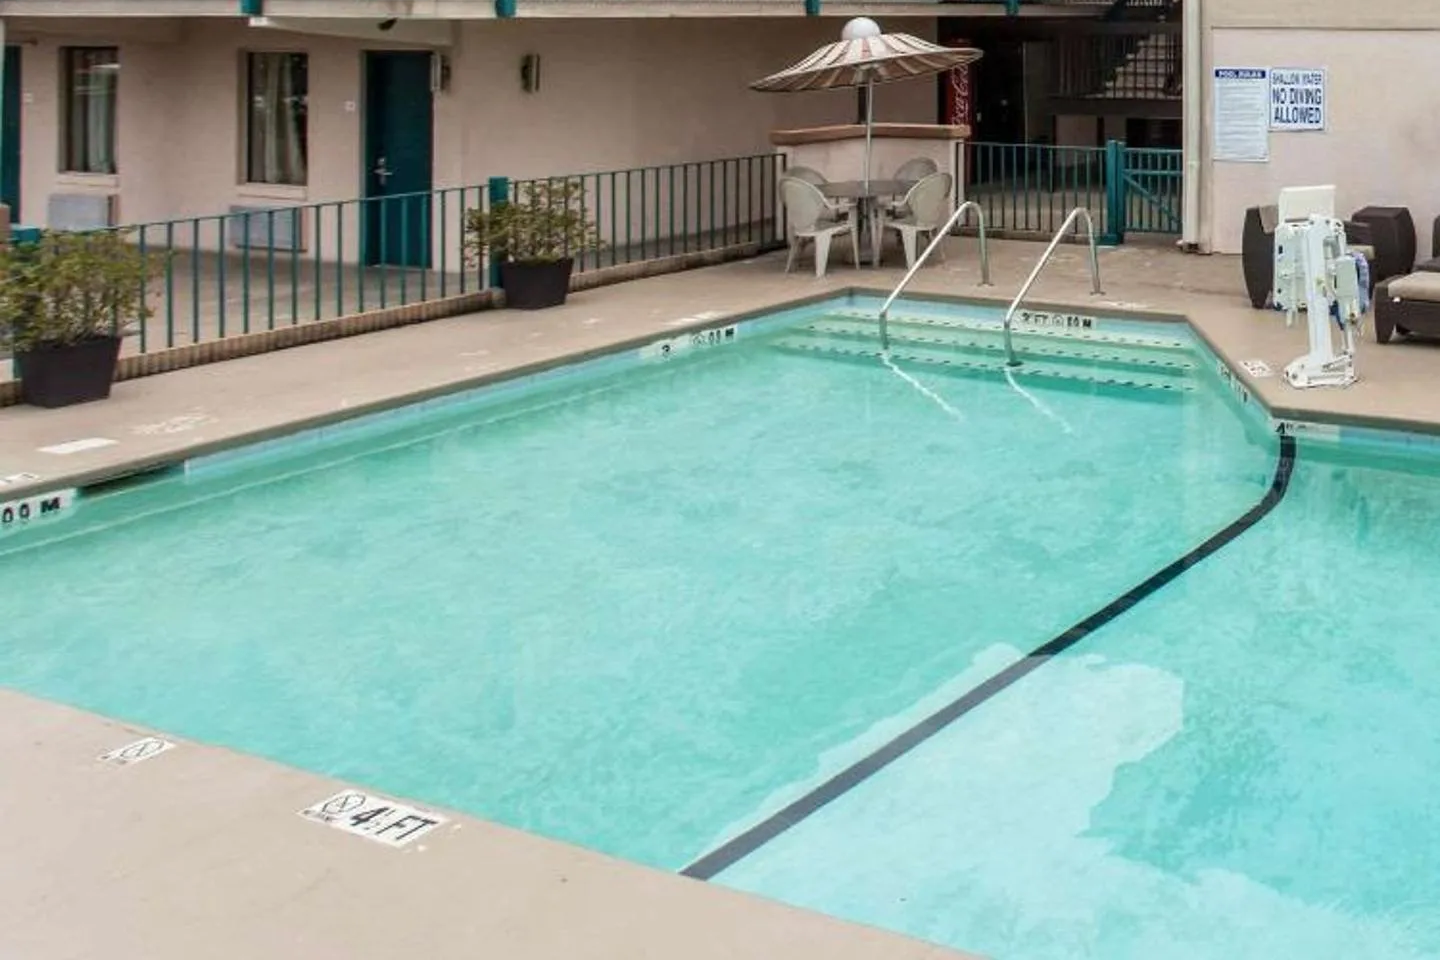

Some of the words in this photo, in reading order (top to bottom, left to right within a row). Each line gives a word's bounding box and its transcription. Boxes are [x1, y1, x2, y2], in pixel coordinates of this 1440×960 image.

[1272, 87, 1286, 104] NO
[1290, 88, 1321, 104] DIVING
[1274, 107, 1321, 124] ALLOWED
[349, 806, 391, 827] 4
[375, 815, 438, 841] FT
